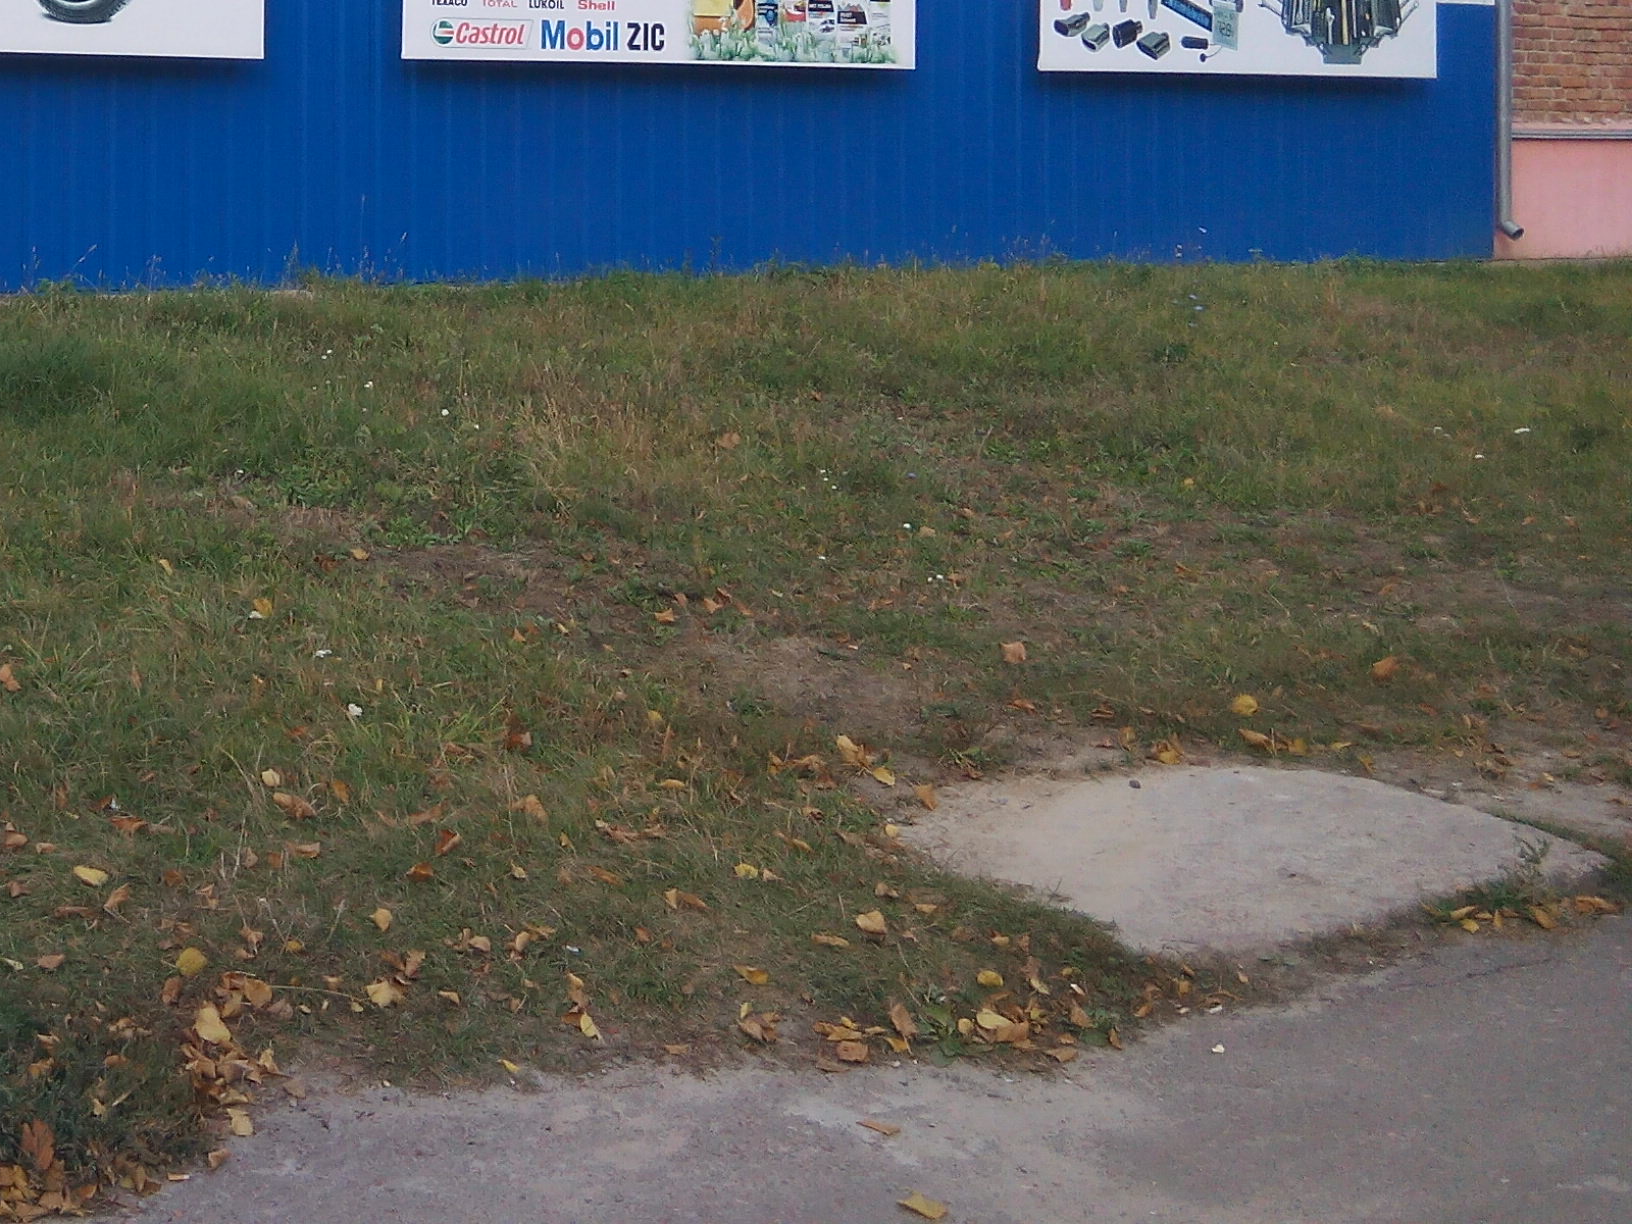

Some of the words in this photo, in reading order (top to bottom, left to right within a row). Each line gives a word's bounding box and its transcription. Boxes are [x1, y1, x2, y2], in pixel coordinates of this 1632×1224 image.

[529, 0, 564, 10] LUKOIL
[578, 0, 615, 11] Shell
[456, 22, 525, 45] Castrol
[541, 19, 618, 51] Mobil
[627, 23, 665, 52] ZIC
